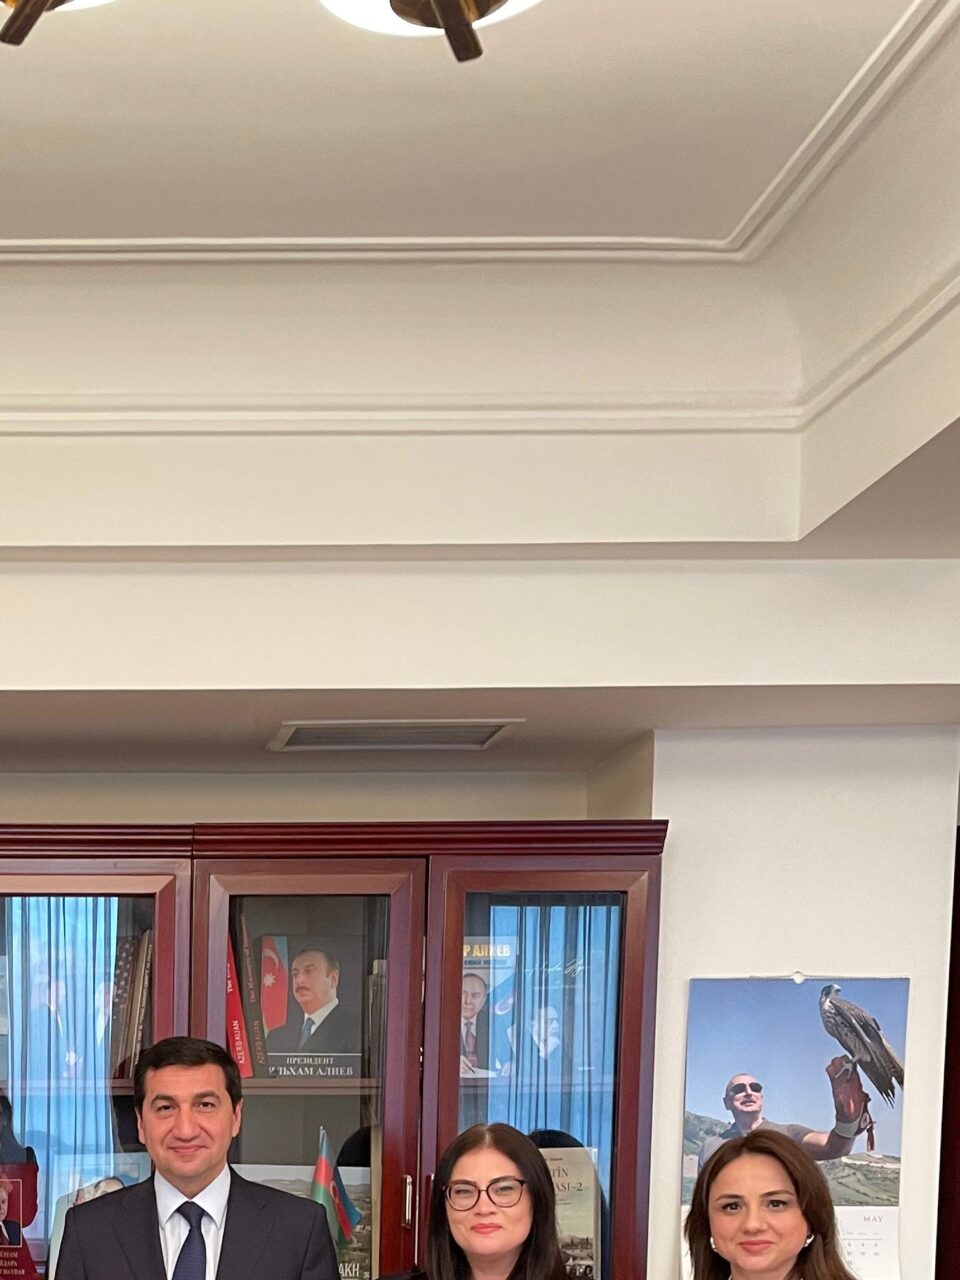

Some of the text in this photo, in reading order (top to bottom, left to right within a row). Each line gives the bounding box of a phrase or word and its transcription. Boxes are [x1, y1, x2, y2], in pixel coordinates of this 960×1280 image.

[232, 1020, 245, 1064] AZERBAIJAN
[316, 1066, 353, 1076] АЛИЕВ
[863, 1215, 883, 1223] MAY
[338, 1262, 360, 1277] AKH
